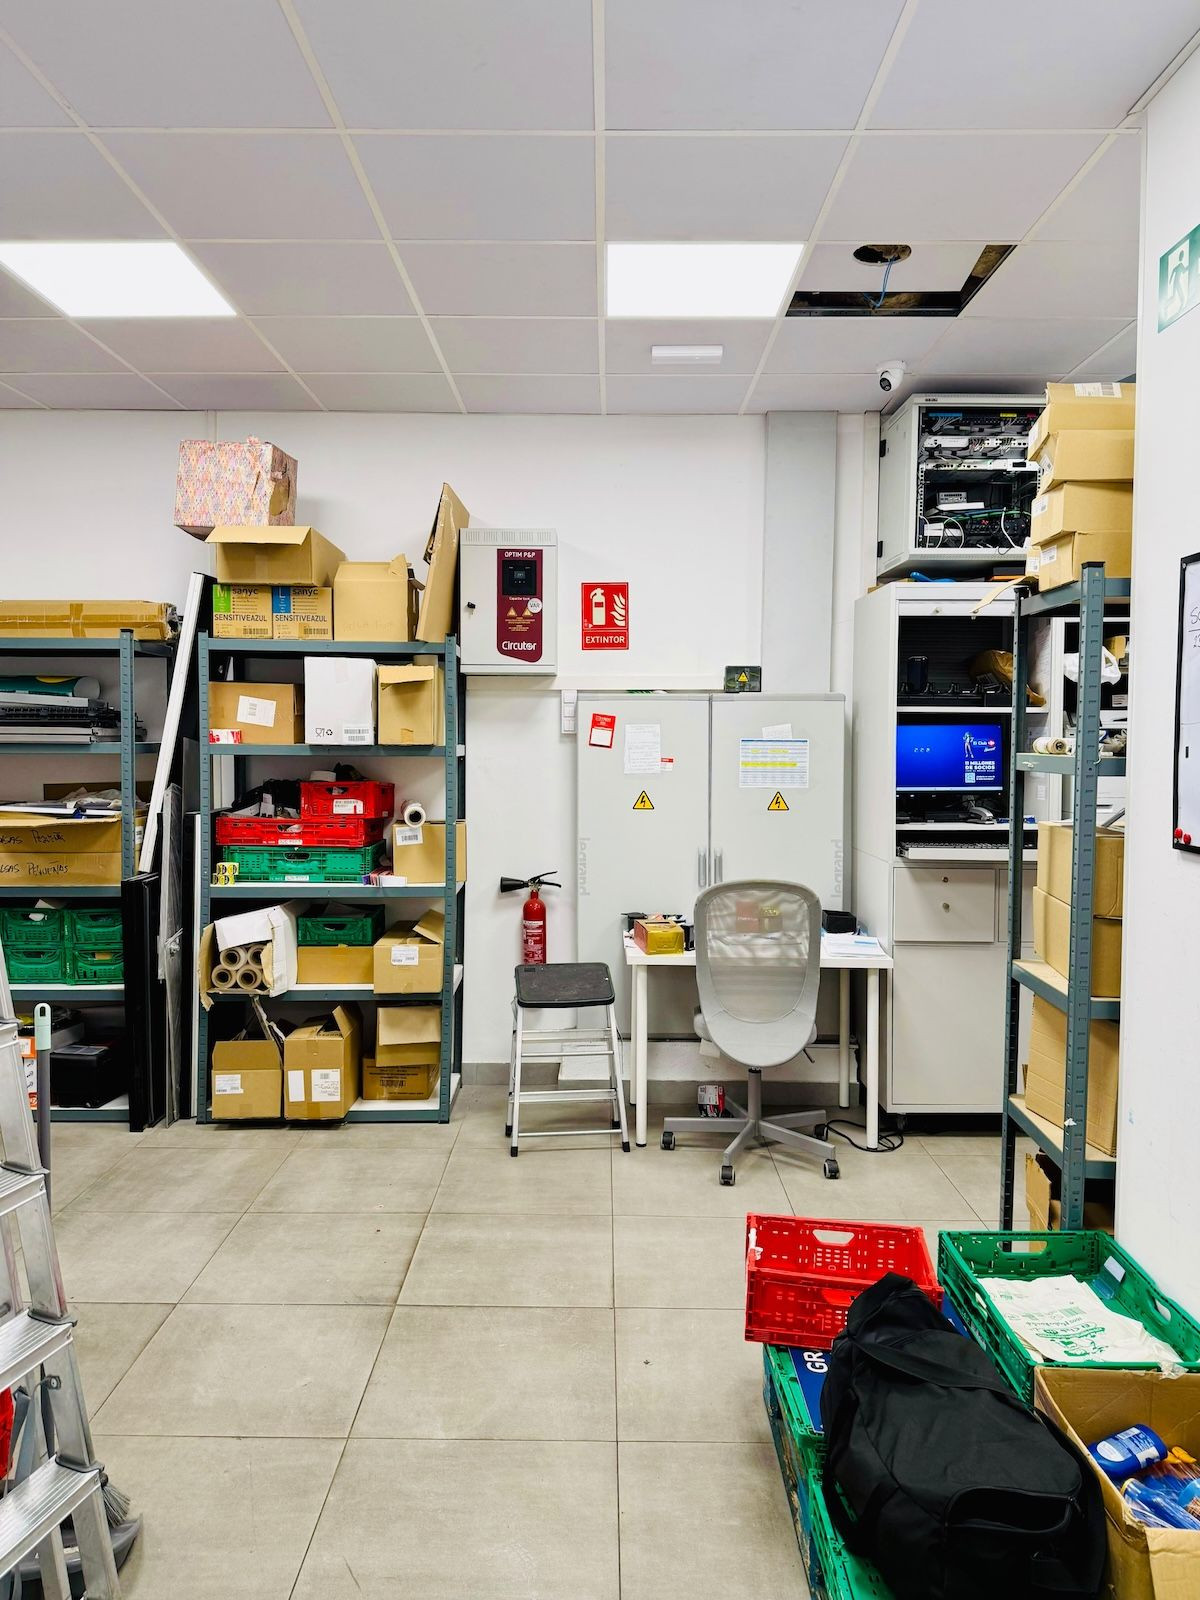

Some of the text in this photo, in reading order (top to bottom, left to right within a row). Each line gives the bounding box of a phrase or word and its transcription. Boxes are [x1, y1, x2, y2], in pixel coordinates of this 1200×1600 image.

[292, 588, 319, 596] sanyc
[585, 635, 625, 643] EXTINTOR
[501, 641, 537, 651] Circutor
